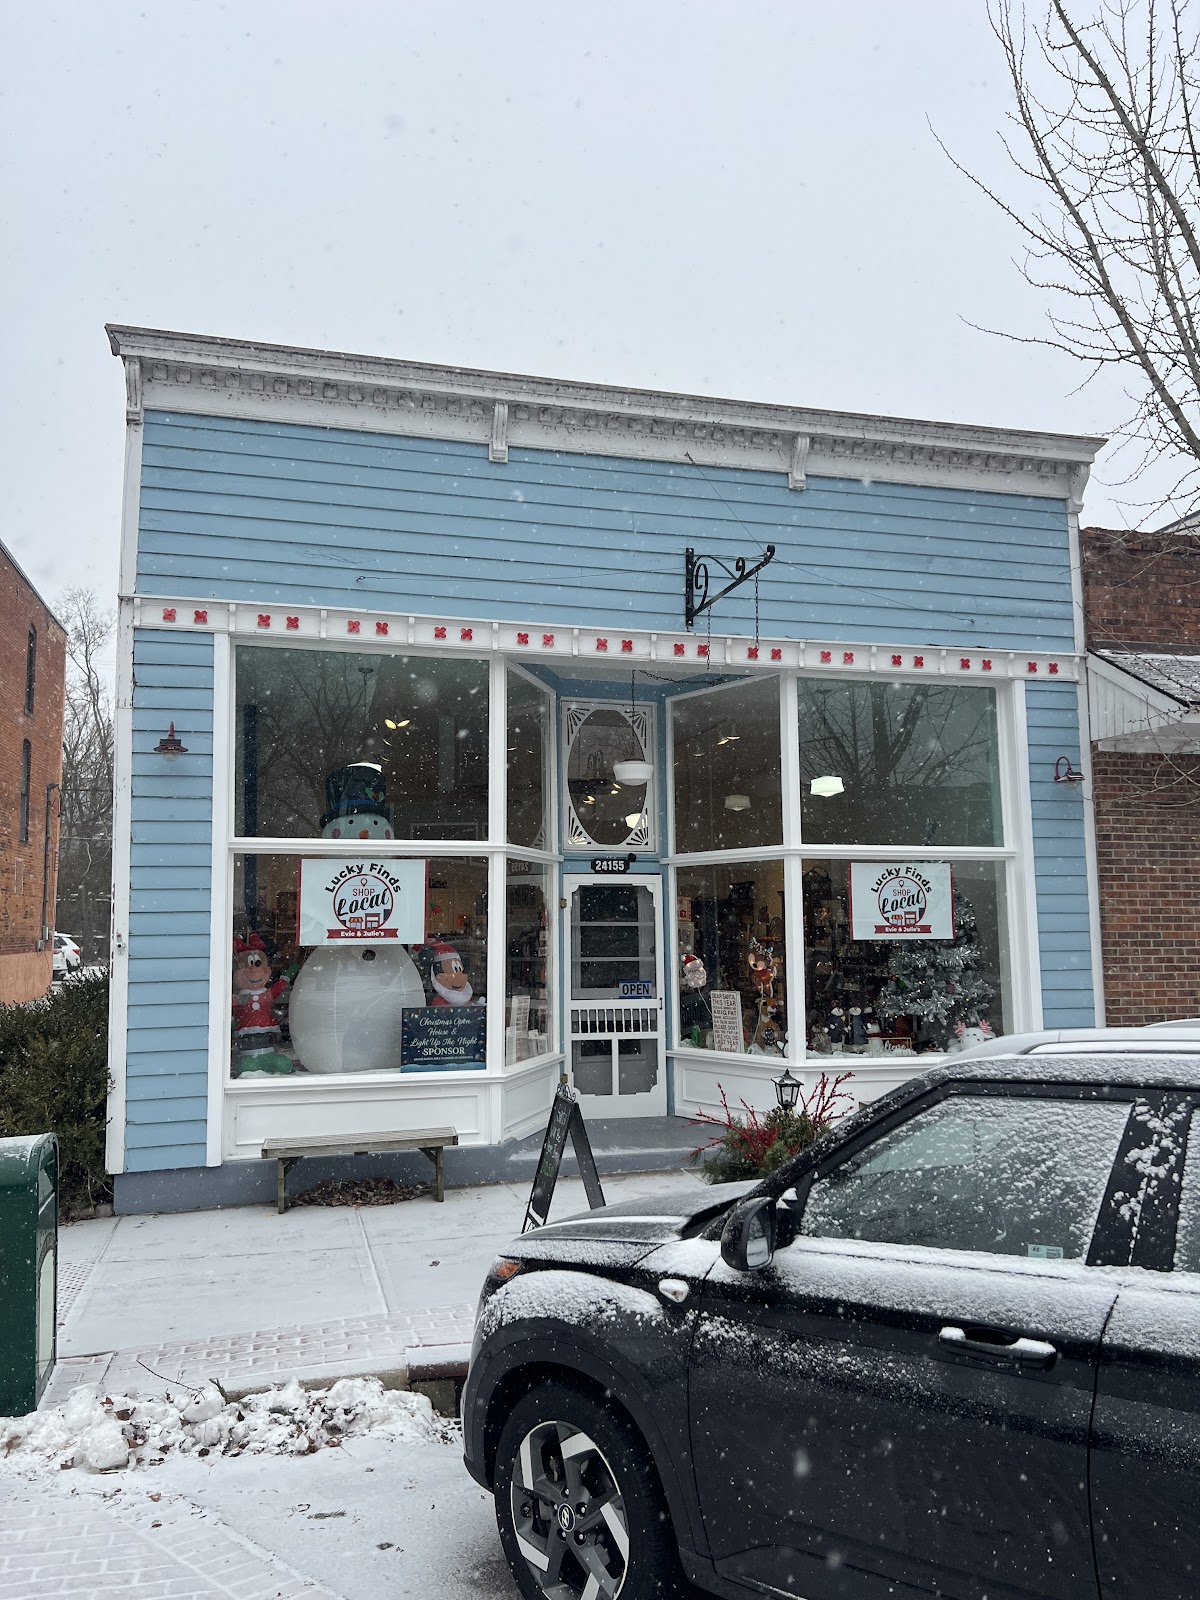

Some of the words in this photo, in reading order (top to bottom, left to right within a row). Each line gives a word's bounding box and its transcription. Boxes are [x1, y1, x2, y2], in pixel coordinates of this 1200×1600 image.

[595, 860, 625, 871] 24155
[325, 863, 365, 893] Lucky
[369, 863, 401, 893] Finds
[870, 867, 900, 893] Lucky
[905, 866, 932, 894] Finds
[352, 888, 375, 896] SHOP
[337, 889, 390, 917] Local
[881, 889, 923, 915] Local
[622, 984, 650, 995] OPEN
[420, 1017, 452, 1027] Christmas
[453, 1017, 472, 1027] Open
[410, 1038, 430, 1049] Light
[430, 1038, 441, 1048] Up
[442, 1038, 454, 1046] The
[457, 1037, 478, 1047] Night
[422, 1047, 465, 1056] SPONSOR
